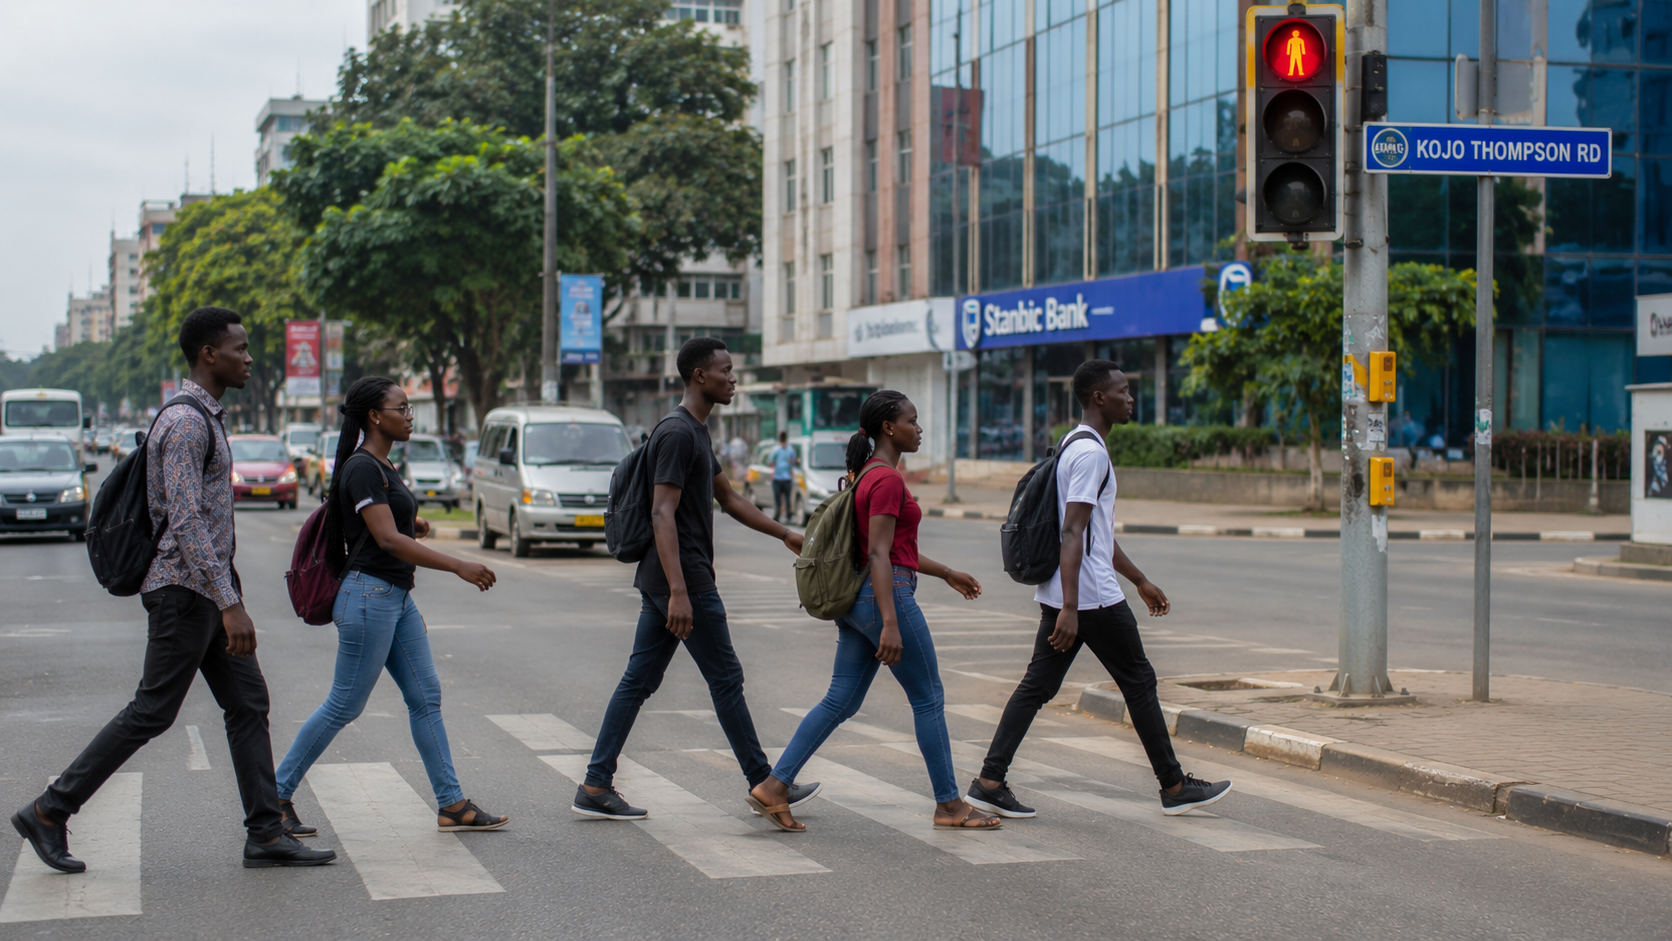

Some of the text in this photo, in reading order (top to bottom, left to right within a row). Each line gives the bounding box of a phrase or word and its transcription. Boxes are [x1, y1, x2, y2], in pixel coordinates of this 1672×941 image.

[1417, 139, 1465, 159] KOJO
[1471, 140, 1571, 162] THOMPSON
[1577, 143, 1601, 163] RD
[984, 293, 1089, 336] Stanbic Bank
